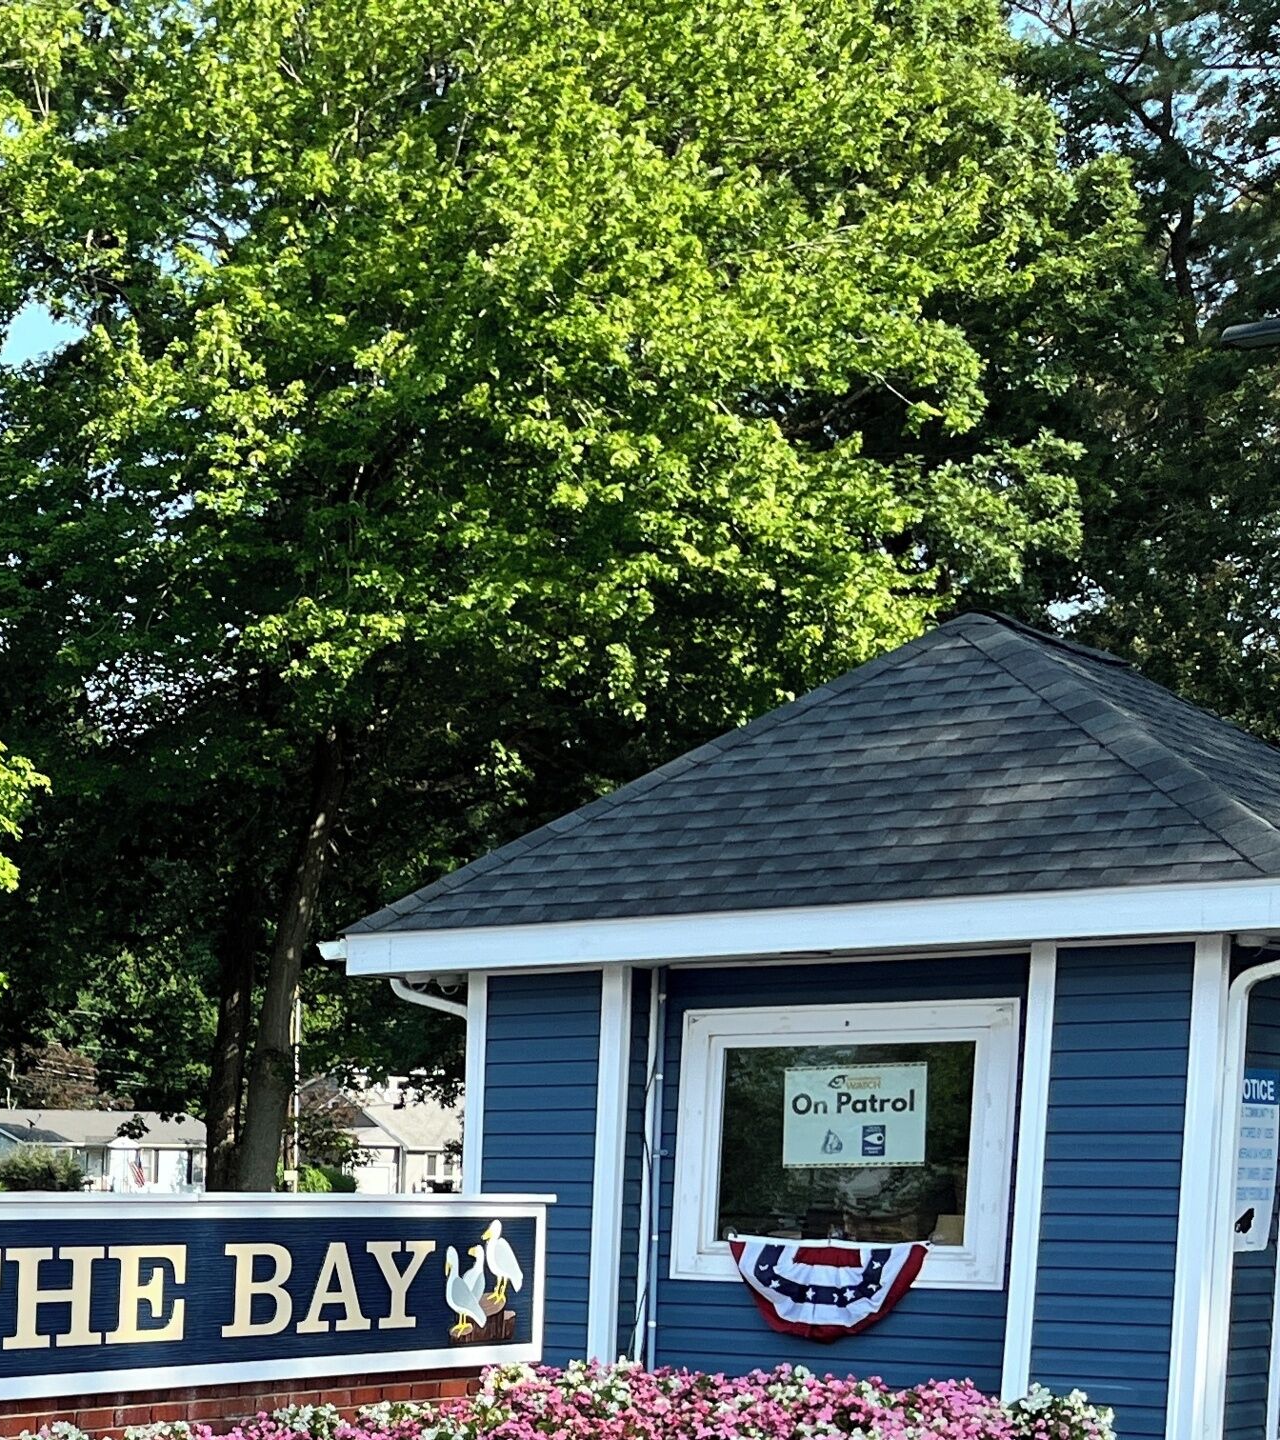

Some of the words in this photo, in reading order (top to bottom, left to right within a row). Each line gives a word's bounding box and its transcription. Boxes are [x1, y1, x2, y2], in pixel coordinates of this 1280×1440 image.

[792, 1093, 828, 1115] On
[837, 1089, 915, 1114] Patrol
[1244, 1079, 1275, 1101] OTICE
[222, 1240, 436, 1338] BAY
